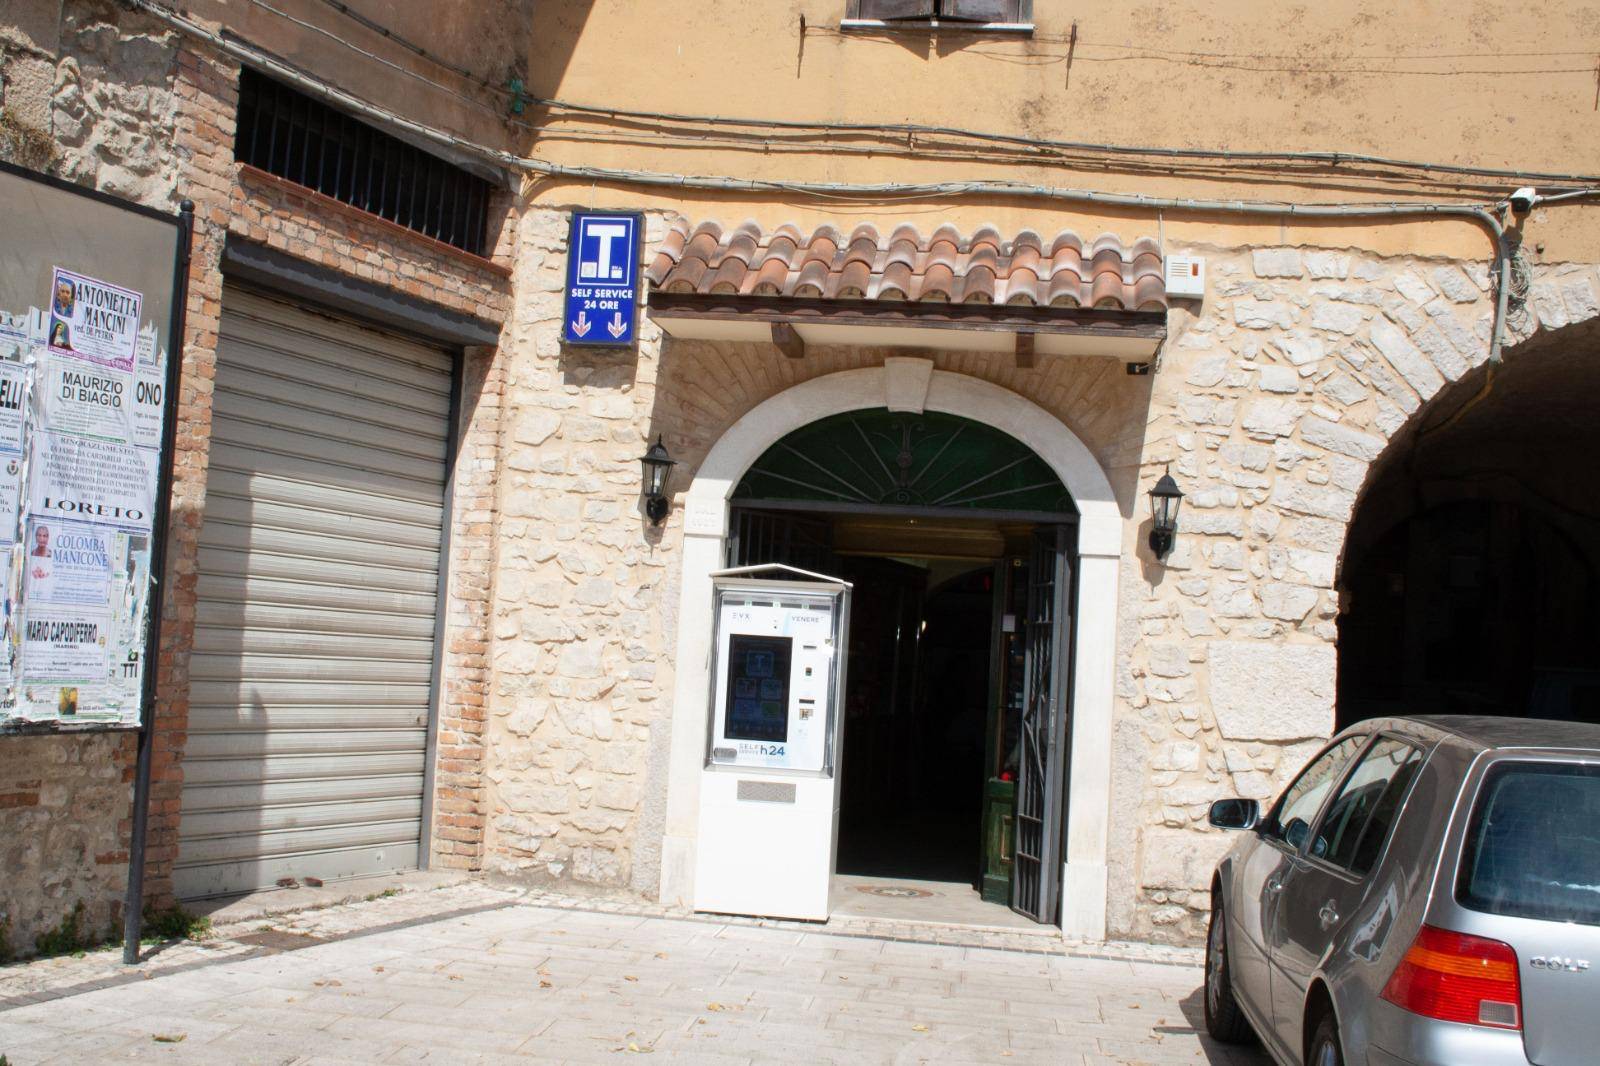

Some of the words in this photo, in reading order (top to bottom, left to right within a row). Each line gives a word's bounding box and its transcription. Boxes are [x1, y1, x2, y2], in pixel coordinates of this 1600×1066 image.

[587, 225, 626, 278] T
[77, 283, 137, 318] ANTONIETTA
[571, 288, 592, 298] SELF
[595, 289, 633, 299] SERVICE
[584, 300, 597, 309] 24
[599, 301, 619, 310] ORE
[84, 306, 126, 334] MANCINI
[62, 371, 123, 394] MAURIZIO
[62, 386, 75, 400] DI
[79, 389, 121, 408] BIAGIO
[44, 497, 143, 520] LORETO
[56, 535, 105, 552] COLOMBA
[53, 549, 109, 567] MANICONE
[27, 620, 49, 642] MARIO
[50, 621, 98, 644] CAPODIFERRO
[760, 745, 785, 756] h24
[1530, 956, 1590, 972] GOLF
